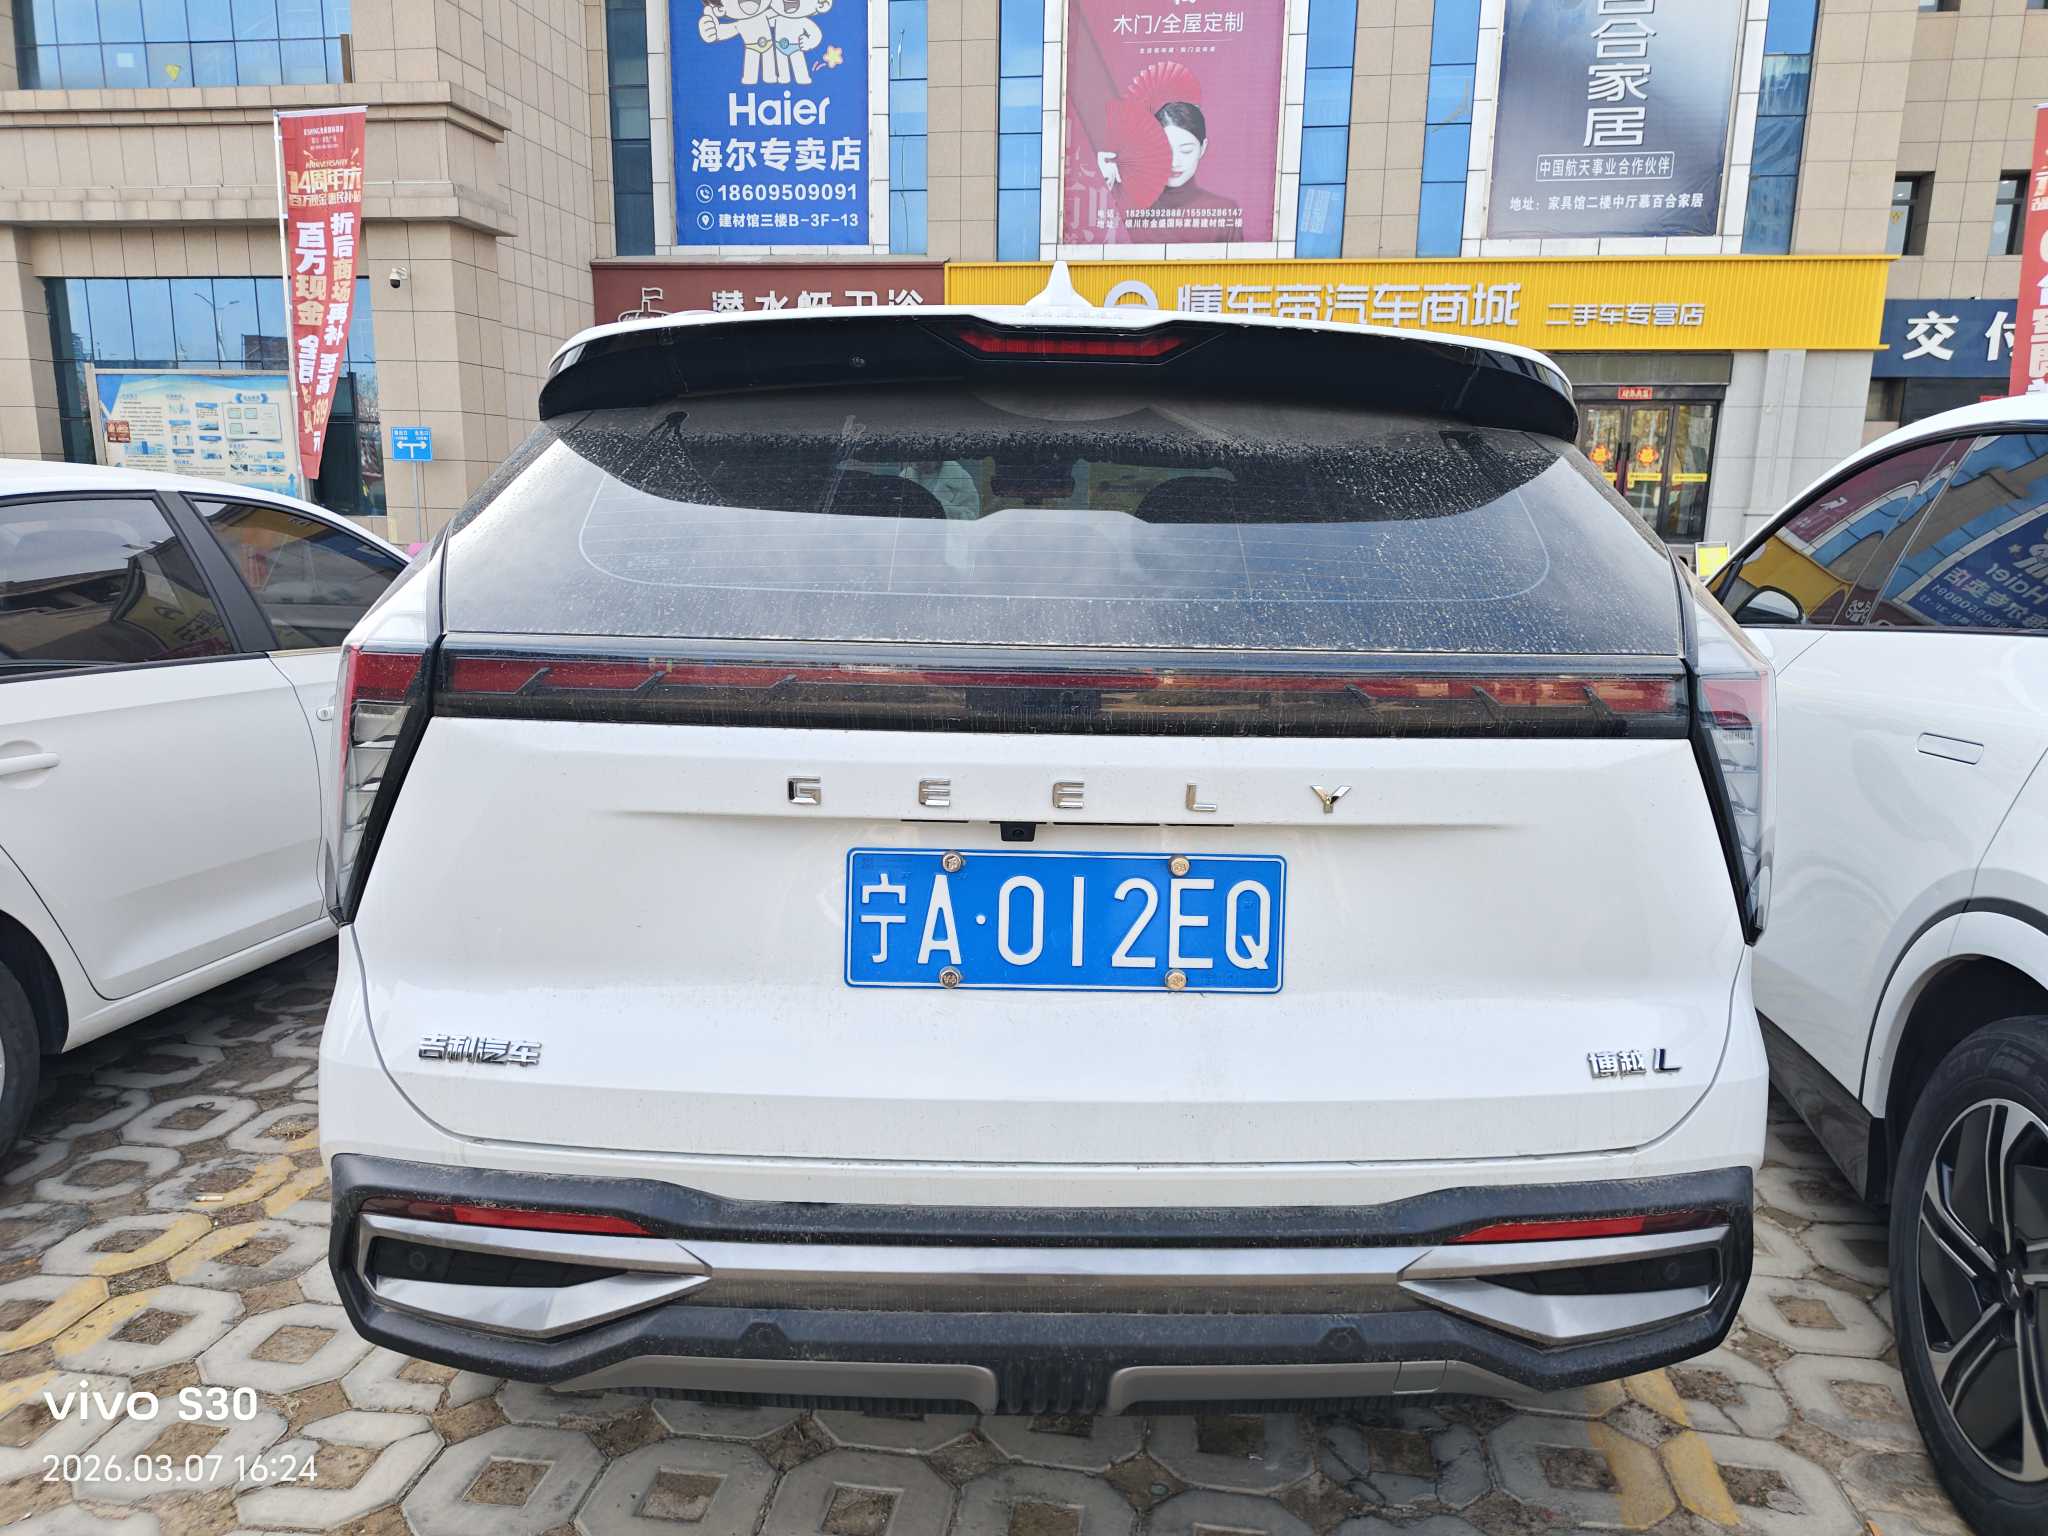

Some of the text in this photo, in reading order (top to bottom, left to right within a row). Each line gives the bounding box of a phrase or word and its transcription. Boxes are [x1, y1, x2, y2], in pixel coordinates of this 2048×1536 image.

[1113, 12, 1244, 36] 木门/全屋定制
[728, 90, 830, 126] Haier
[691, 137, 862, 172] 海尔专卖店
[1539, 157, 1670, 177] 中国航天事业合作伙伴
[718, 183, 857, 201] 18609509091
[293, 221, 327, 326] 百万现金
[1177, 282, 1520, 326] 懂车帝汽车商城
[1545, 303, 1705, 326] 二手车专营店
[788, 777, 1346, 814] GEELY
[418, 1034, 541, 1066] 吉利汽车
[1586, 1048, 1682, 1078] 博越 L
